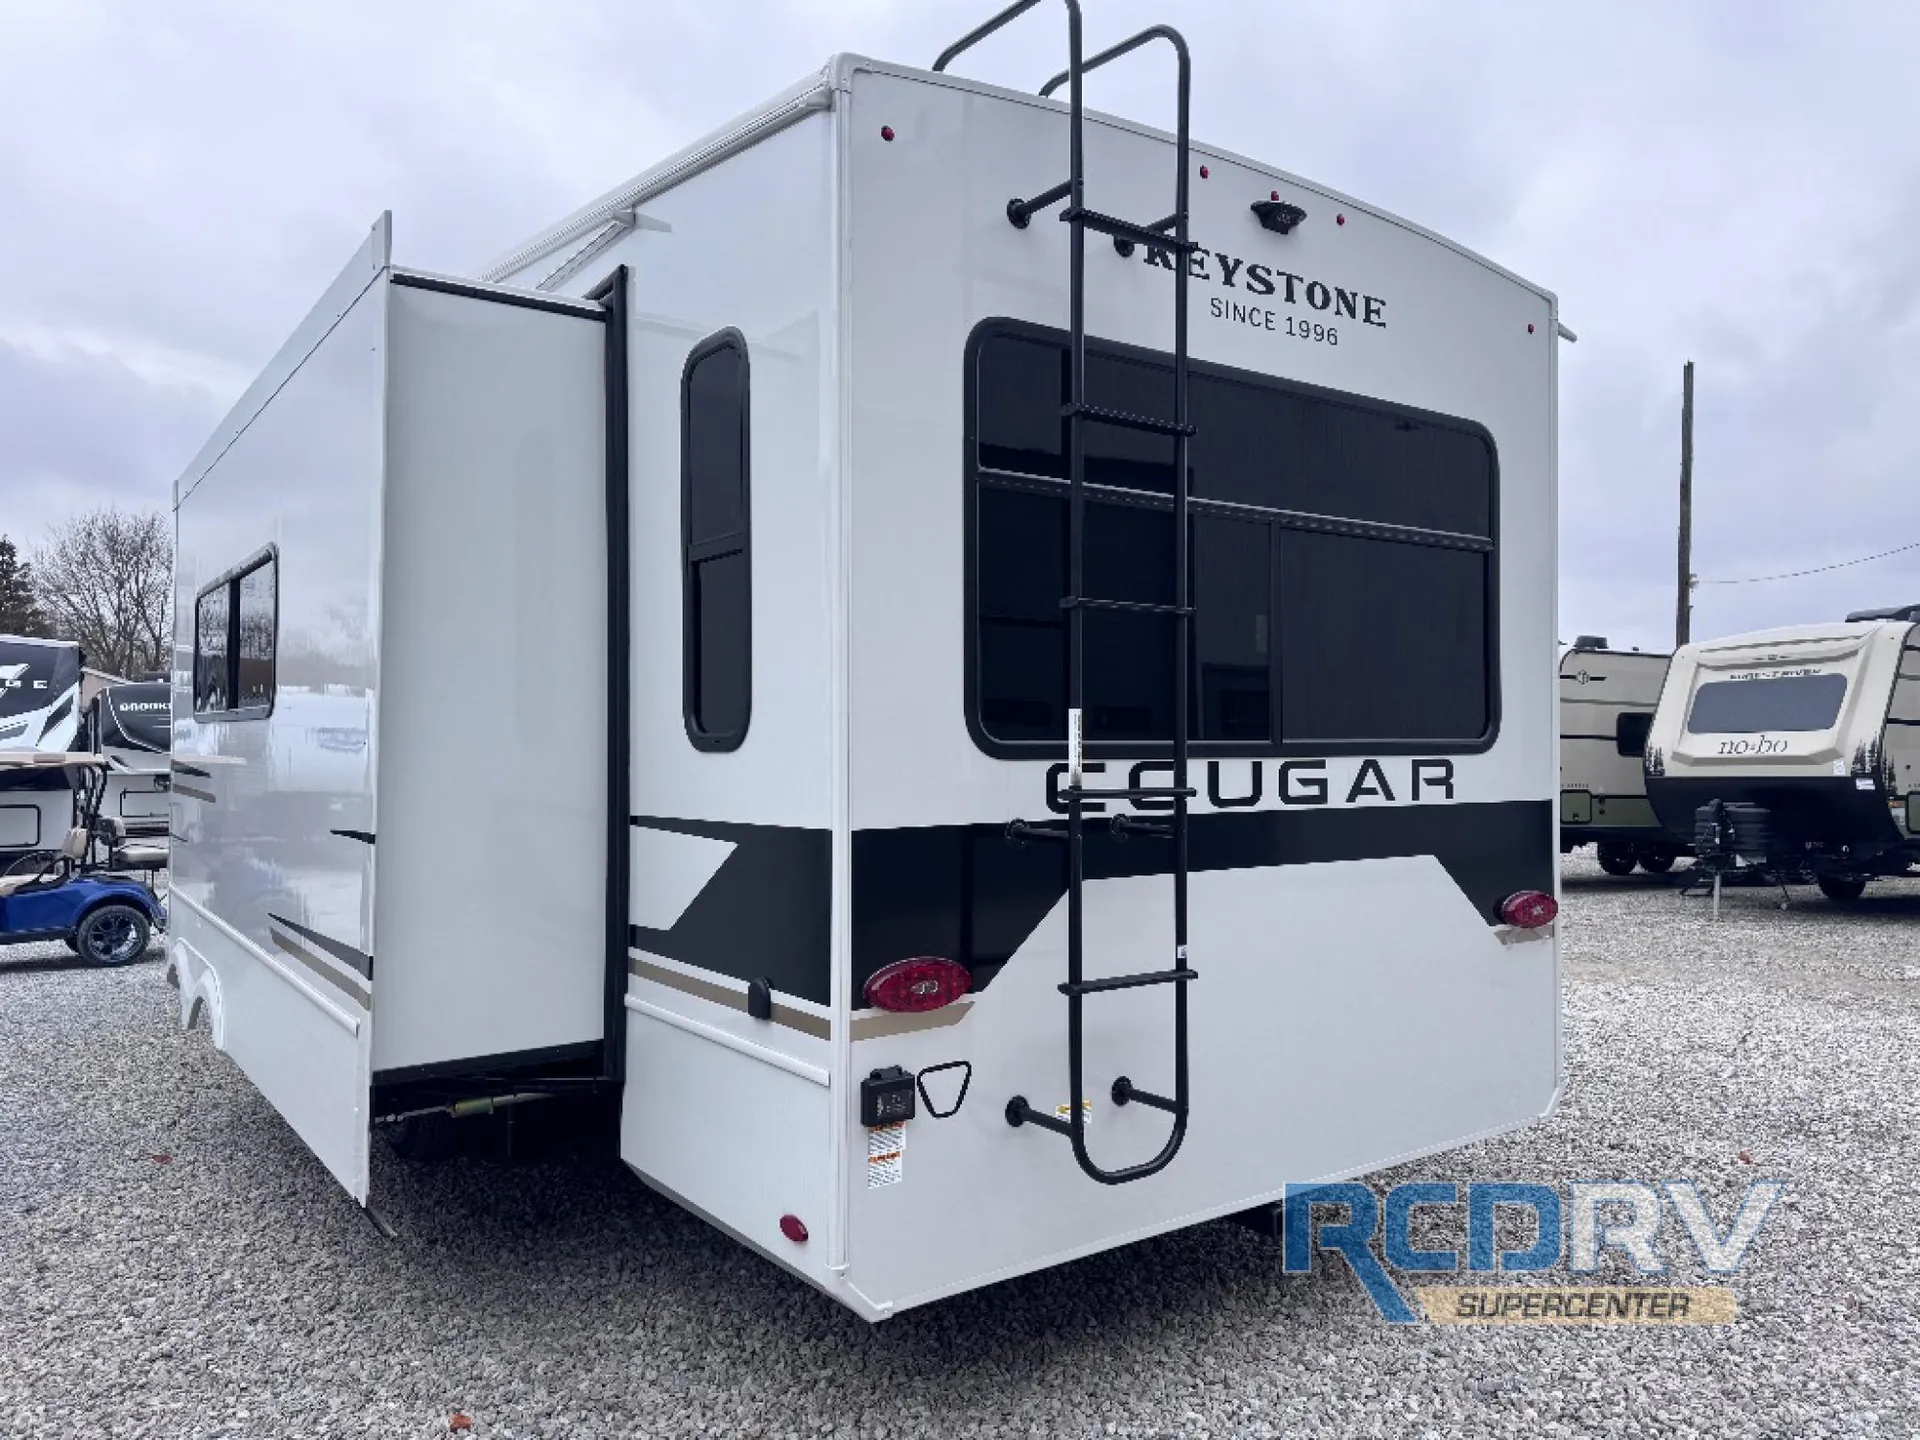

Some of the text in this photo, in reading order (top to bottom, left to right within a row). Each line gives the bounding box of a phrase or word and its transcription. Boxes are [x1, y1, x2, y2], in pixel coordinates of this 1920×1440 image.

[1143, 240, 1386, 328] KEYSTONE
[1210, 298, 1338, 346] SINCE 1996
[1045, 758, 1455, 814] COUGAR
